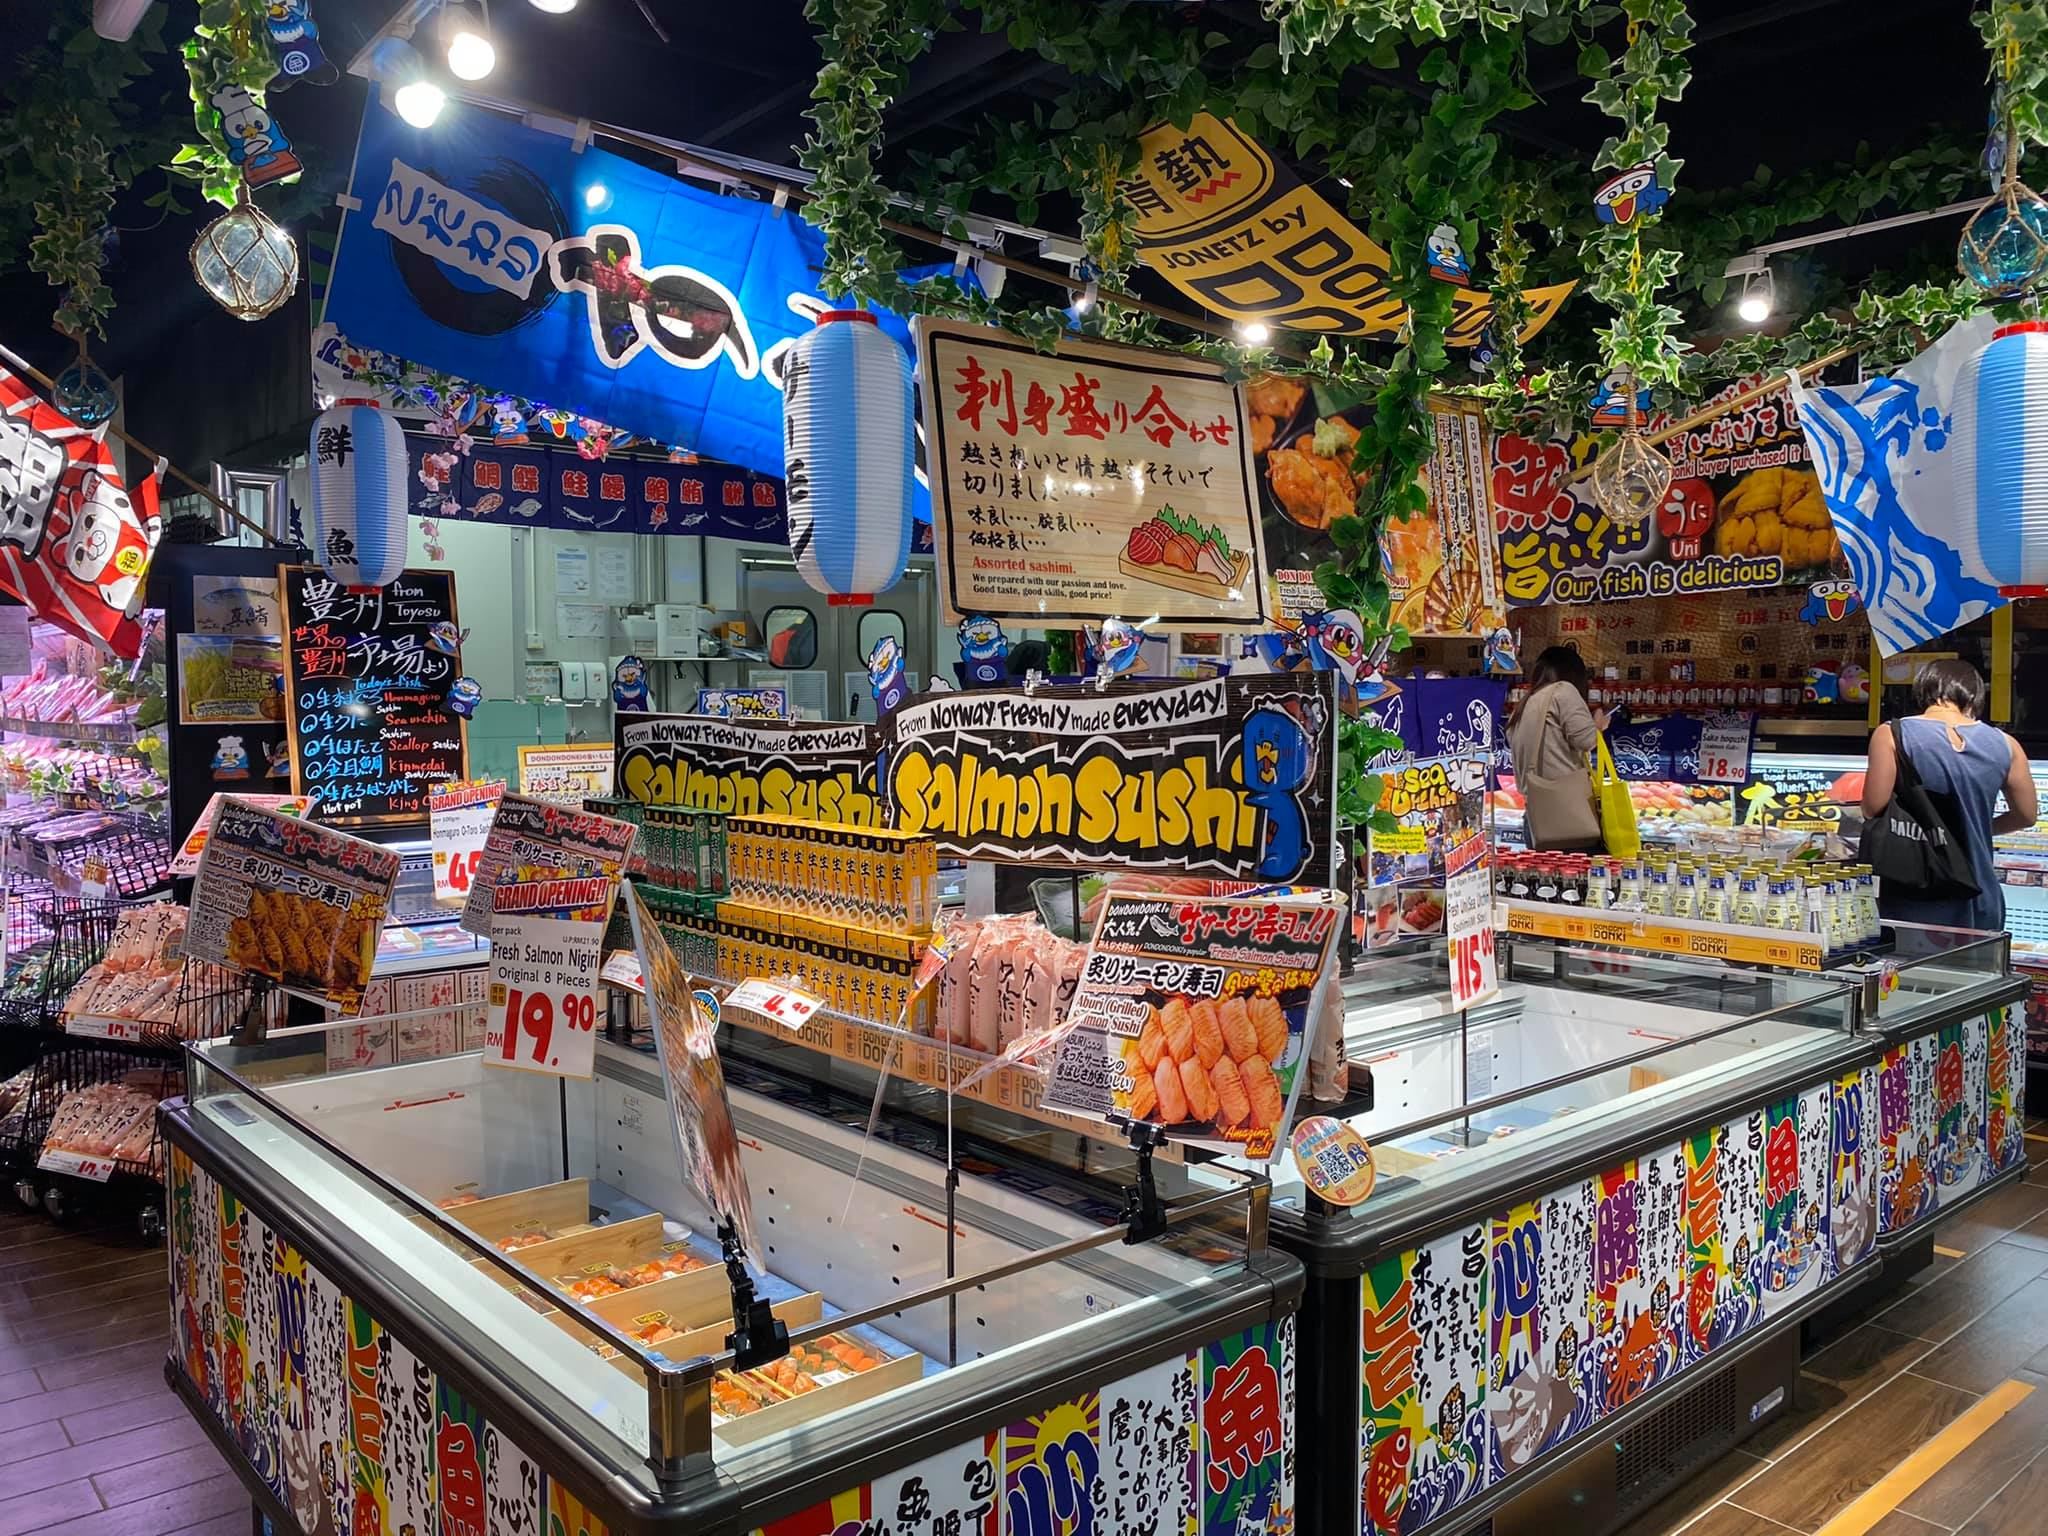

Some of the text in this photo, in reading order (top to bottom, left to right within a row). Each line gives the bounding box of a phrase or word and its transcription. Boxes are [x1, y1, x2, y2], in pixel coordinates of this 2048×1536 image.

[384, 180, 541, 283] こだわり
[1161, 205, 1307, 269] JONETZ by
[954, 356, 1235, 449] 刺身盛り合わせ
[1699, 459, 1728, 479] buyer
[1731, 449, 1787, 475] purchased
[1790, 447, 1801, 461] it
[1669, 488, 1709, 535] うに
[1671, 540, 1700, 560] Uni
[973, 556, 1077, 575] Assorted sashimi.
[973, 573, 1127, 591] We prepared with our passion and love.
[1277, 570, 1297, 582] DON
[1556, 560, 1778, 598] Our fish is delicious
[391, 582, 424, 597] from
[973, 584, 1112, 600] Good taste, good skills, good price!
[396, 604, 441, 623] Toyosu
[899, 717, 926, 738] From
[998, 700, 1071, 732] Freshly
[1072, 711, 1110, 732] made
[388, 737, 430, 753] Scallop
[624, 730, 649, 744] From
[702, 725, 757, 748] Freshly
[757, 739, 786, 752] made
[1403, 763, 1447, 791] Sea
[322, 798, 363, 815] Hot pot
[389, 796, 419, 812] King
[431, 790, 462, 810] GRAND
[1391, 788, 1458, 816] Urchin
[437, 880, 448, 888] RM
[494, 881, 539, 911] GRAND
[491, 926, 522, 937] per pack
[1593, 930, 1627, 943] DONKI
[491, 941, 519, 960] Fresh
[524, 944, 564, 965] Salmon
[568, 948, 599, 972] Nigiri
[1238, 948, 1272, 964] Salmon
[1691, 943, 1728, 955] DONKI
[498, 966, 591, 988] Original 8 Pieces
[1087, 954, 1224, 997] 炙りサーモン寿司
[1077, 995, 1148, 1020] Aburi (Grilled)
[1110, 1017, 1141, 1035] Sushi
[486, 1032, 503, 1047] RM
[1061, 1047, 1125, 1072] 炙ったサーモンの
[1225, 1127, 1271, 1142] Amazing
[1492, 1219, 1543, 1321] 心
[1203, 1345, 1283, 1494] 魚
